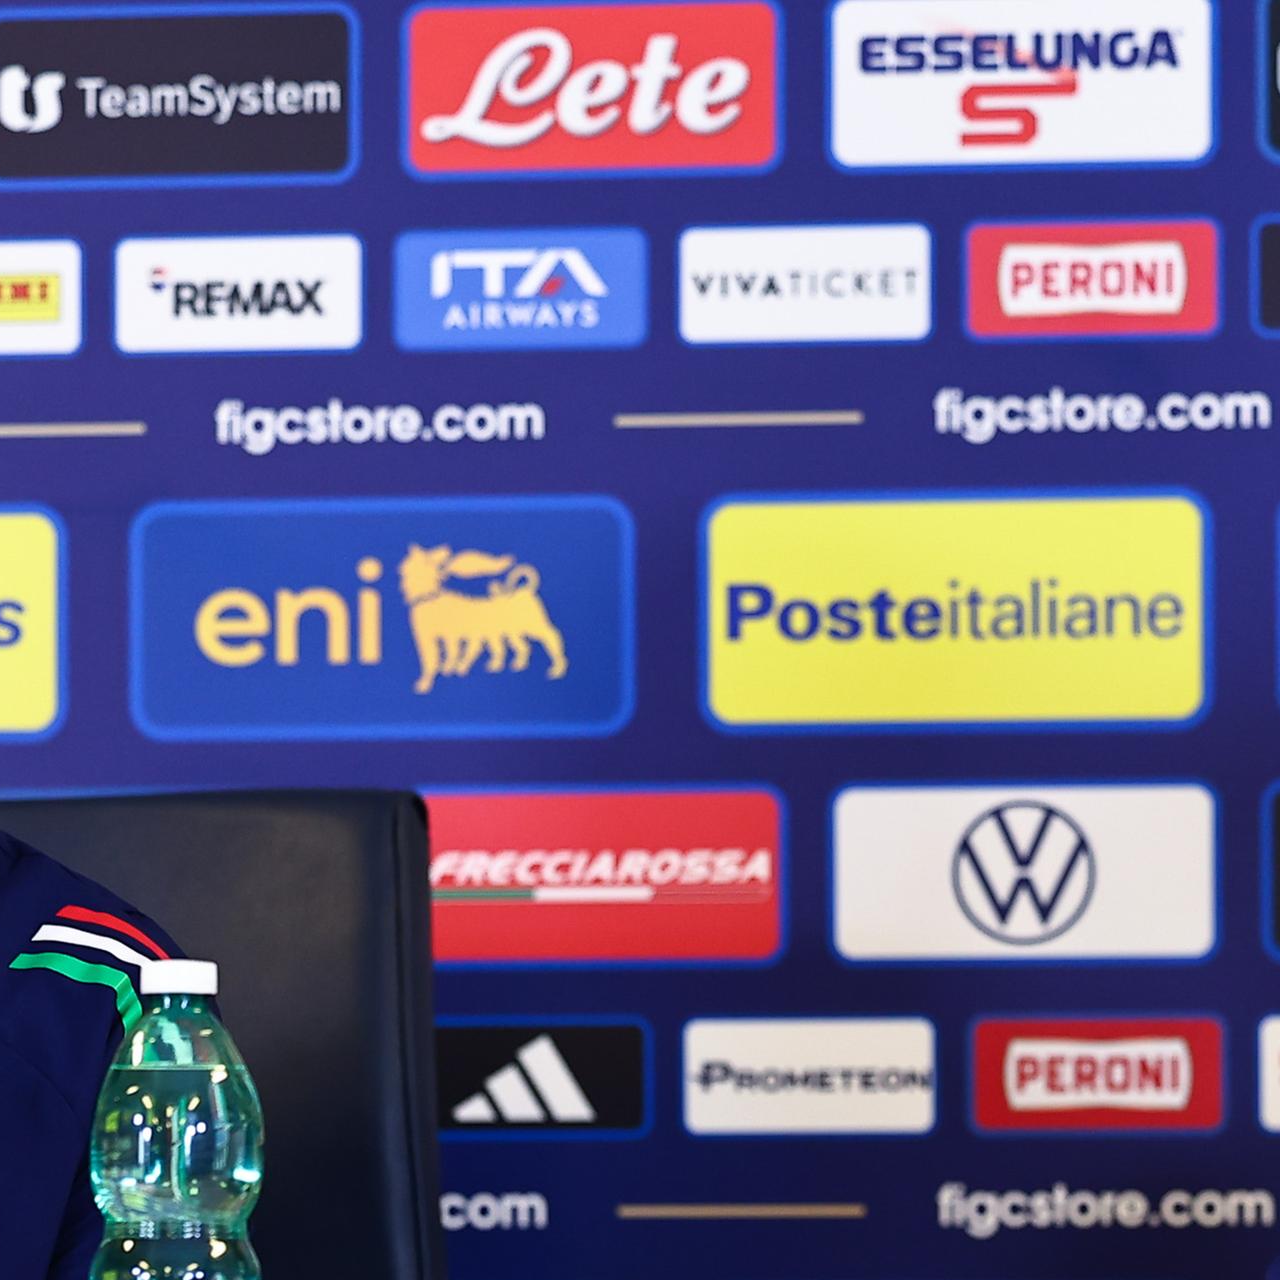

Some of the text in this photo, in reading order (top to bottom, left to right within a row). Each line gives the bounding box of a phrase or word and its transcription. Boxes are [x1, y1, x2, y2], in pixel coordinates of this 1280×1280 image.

[858, 29, 1182, 73] ESSELUNGA
[75, 74, 341, 124] TeamSystem
[421, 28, 751, 147] Lete
[430, 247, 608, 298] ITA
[692, 268, 918, 300] VIVATICKET
[1010, 261, 1176, 300] PERONI
[443, 300, 600, 330] AIRWAYS
[215, 396, 546, 455] figcstore.com
[933, 386, 1271, 444] figcstore.com
[194, 557, 383, 667] eni
[725, 578, 1185, 643] Posteitaliane
[428, 848, 771, 886] FRECCIAROSSA
[696, 1060, 933, 1094] PROMETEON
[1015, 1057, 1182, 1093] PERONI
[937, 1183, 1276, 1238] figcstore.com
